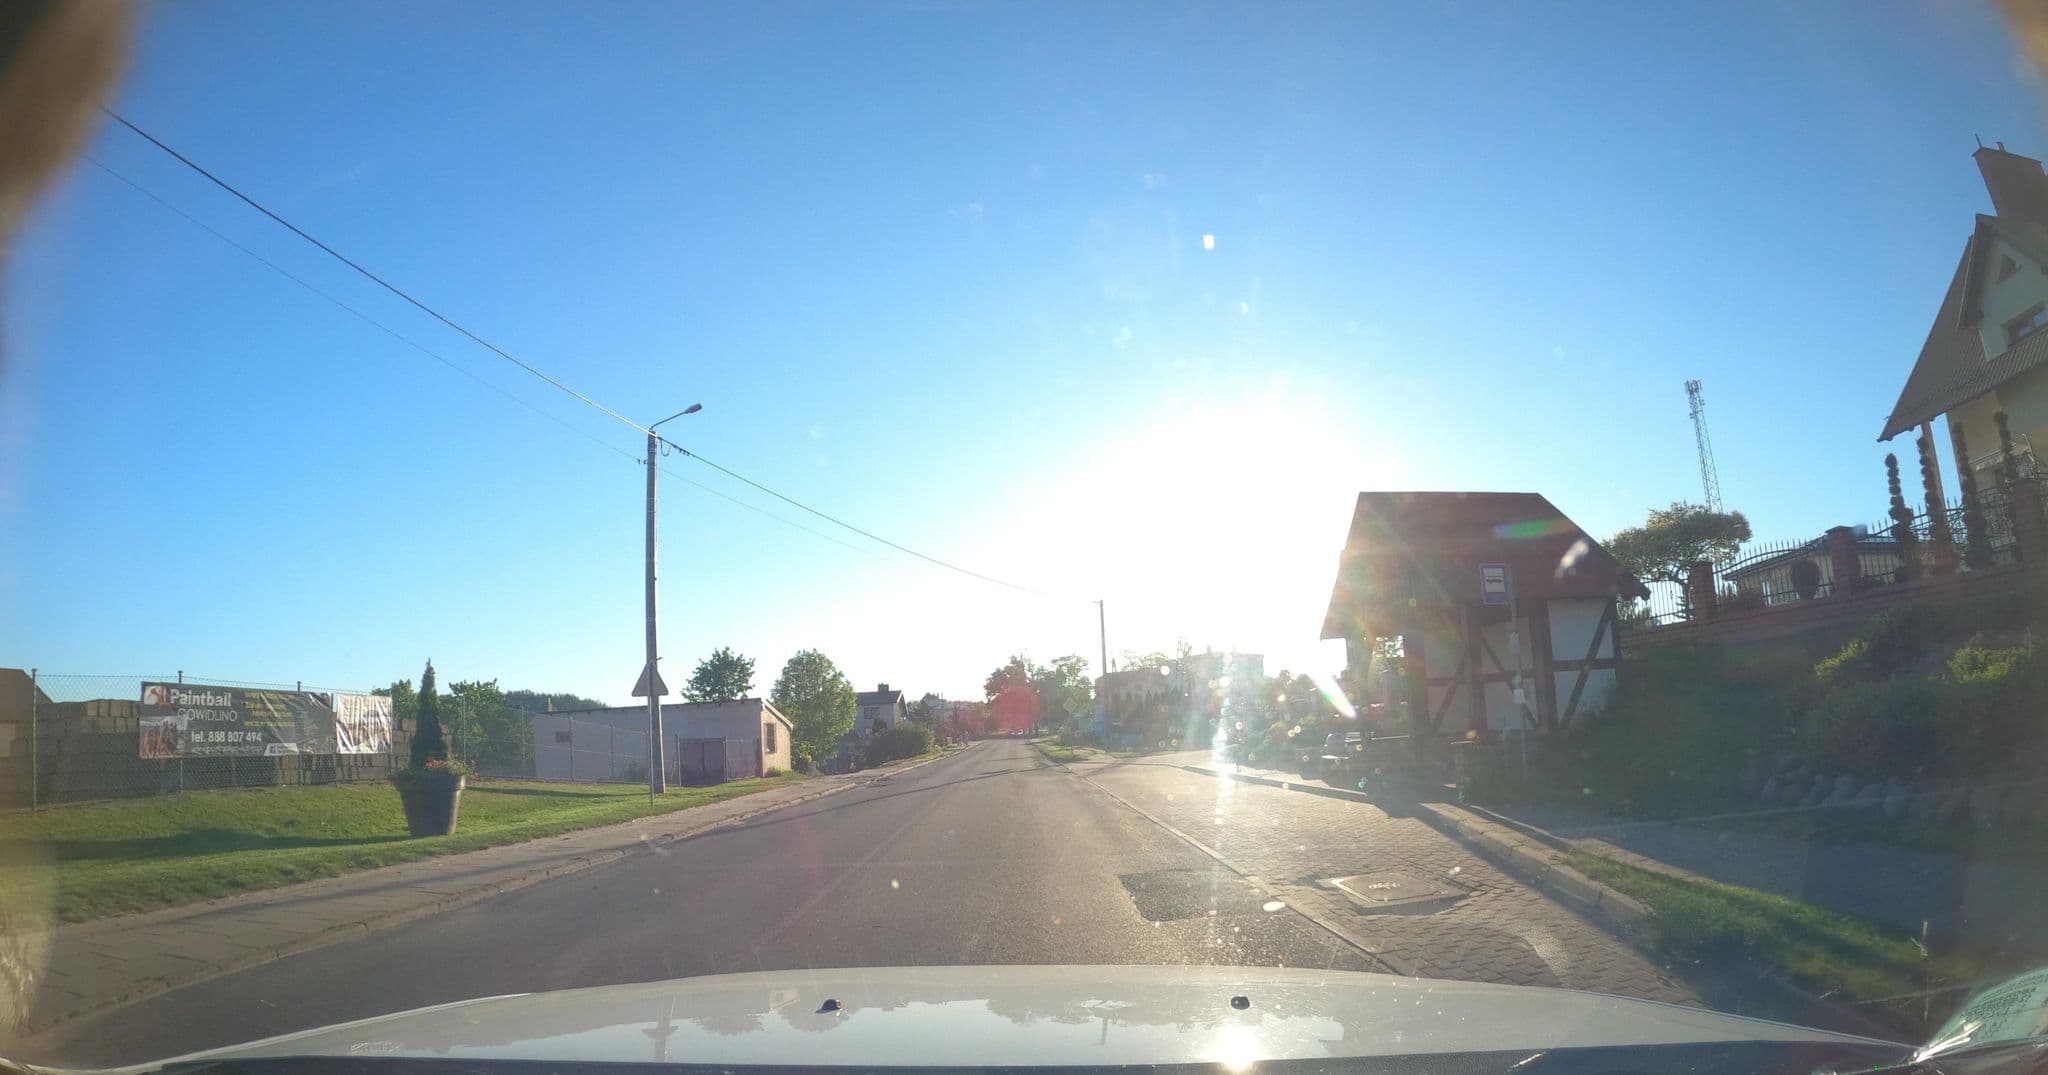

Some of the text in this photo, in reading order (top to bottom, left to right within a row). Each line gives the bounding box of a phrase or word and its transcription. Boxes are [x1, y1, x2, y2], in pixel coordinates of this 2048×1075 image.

[169, 688, 232, 707] Paintball
[191, 731, 262, 743] tel. 888 807 494
